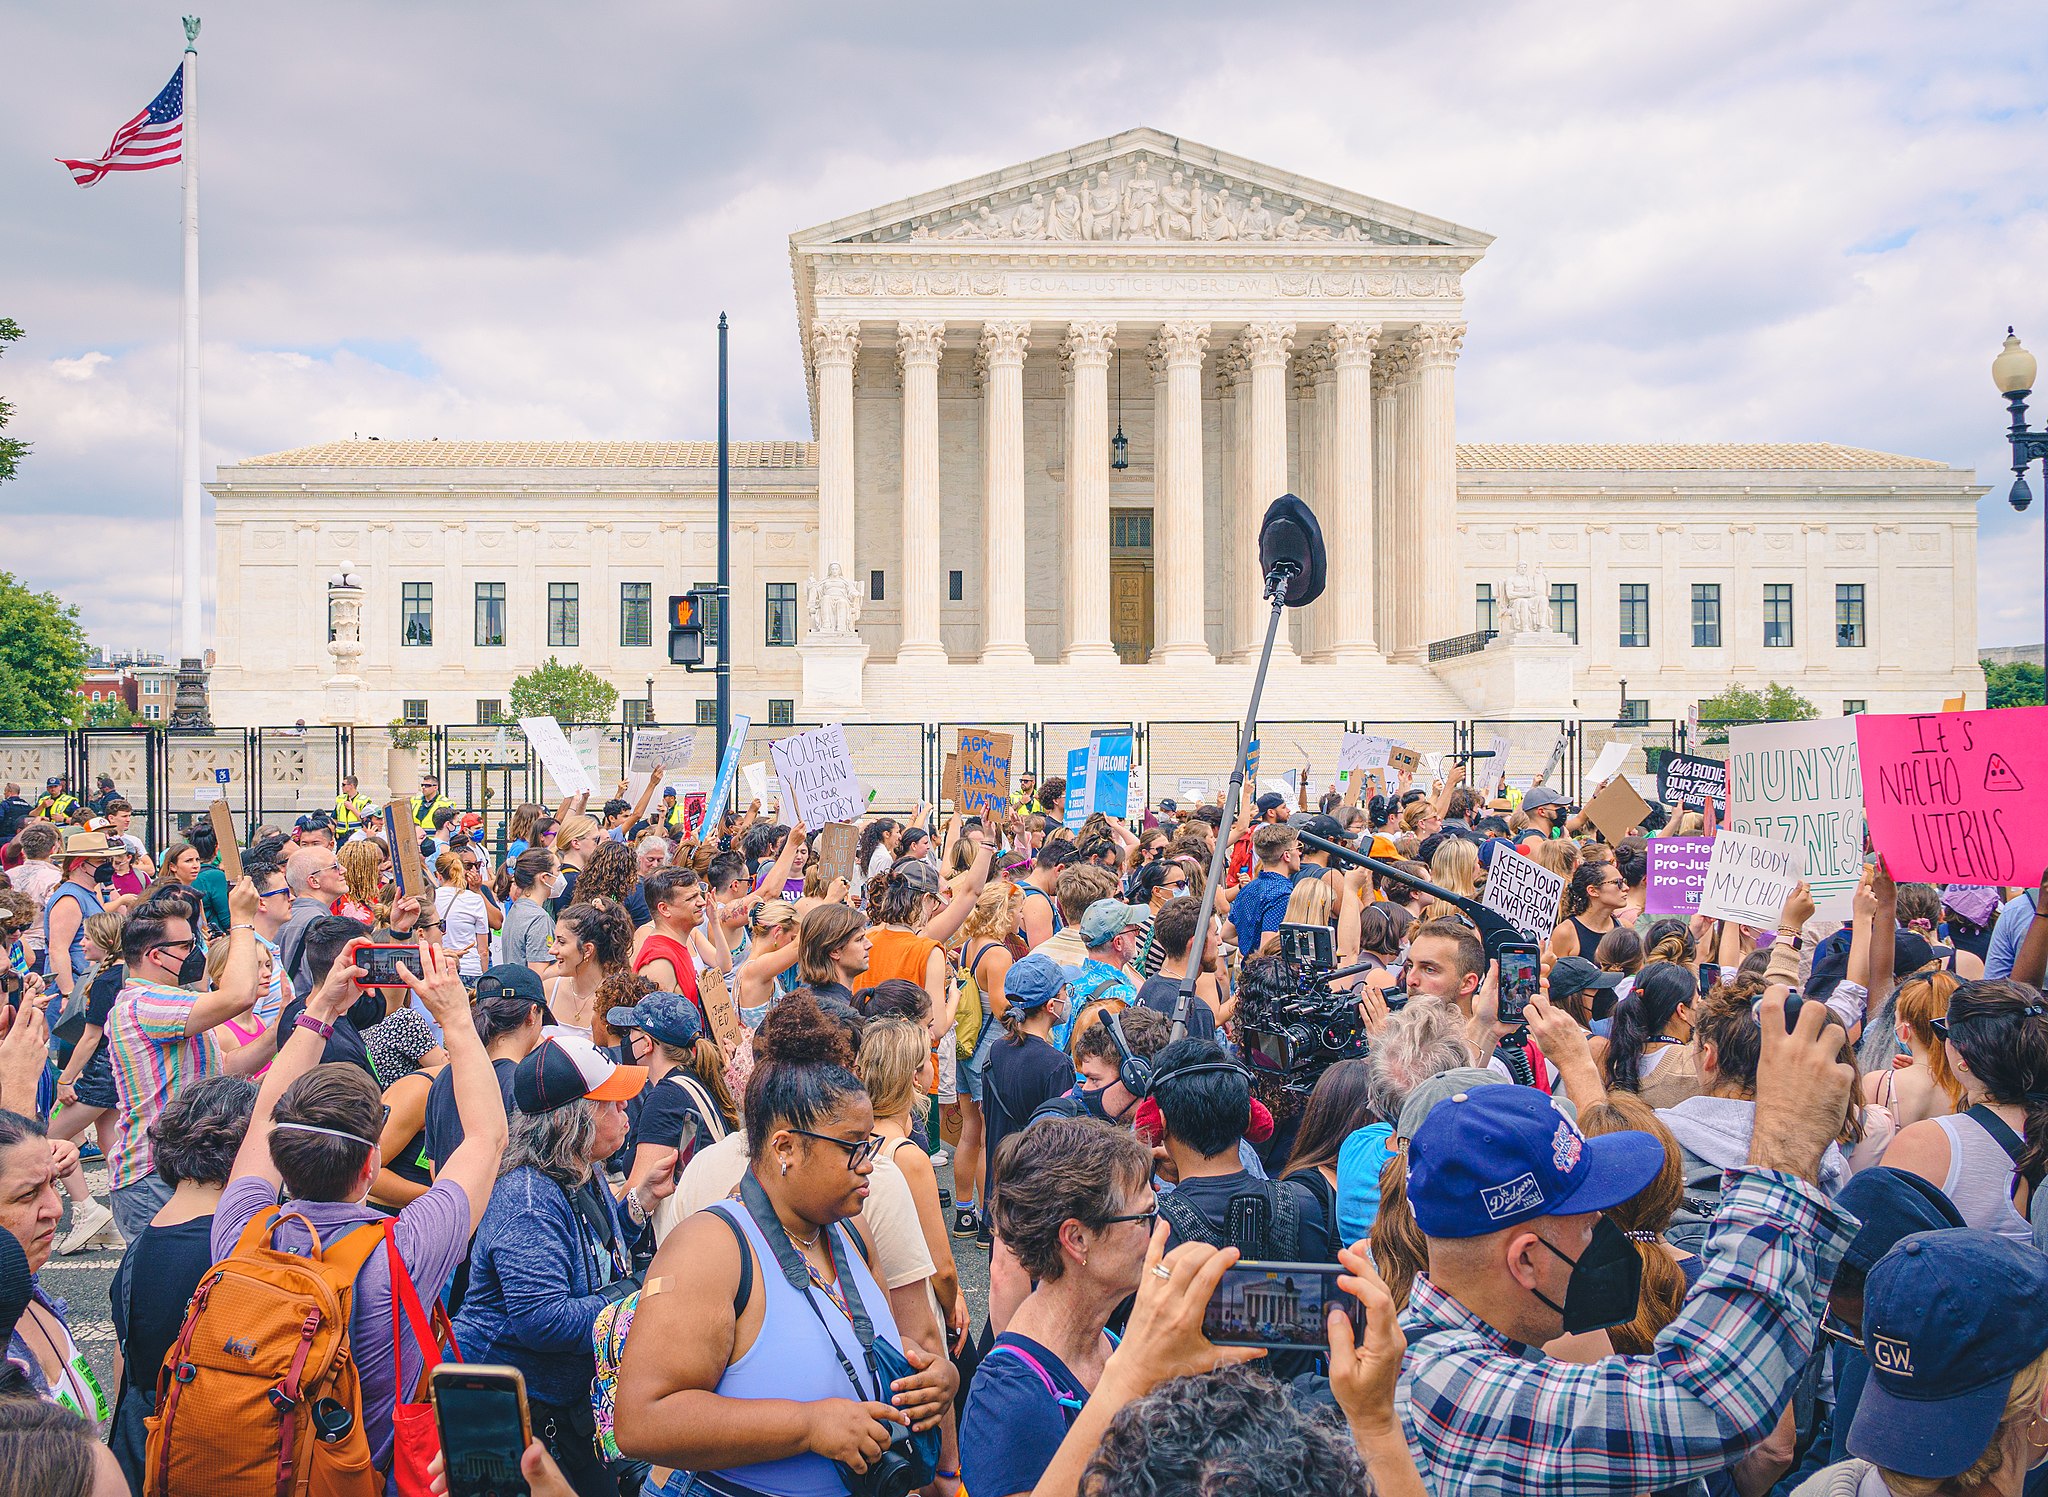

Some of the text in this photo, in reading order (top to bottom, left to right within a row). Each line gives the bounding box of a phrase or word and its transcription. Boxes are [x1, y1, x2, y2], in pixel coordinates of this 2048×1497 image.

[1018, 277, 1261, 293] EQUAL JUSTICE UNDER LAW
[774, 730, 841, 767] YOU ARE
[1908, 715, 1974, 753] It's
[815, 745, 841, 761] THE
[1097, 755, 1129, 772] WELCOME
[783, 759, 847, 793] VILLAIN
[1665, 775, 1692, 791] OUR
[1667, 758, 1726, 783] Our BODIE
[1733, 741, 1863, 802] NUNYA
[1879, 757, 1962, 806] NACHO
[806, 787, 840, 805] IN OUR
[1665, 787, 1684, 801] Our
[834, 849, 848, 863] YOU
[1654, 842, 1713, 854] Pro-Fre
[1719, 840, 1790, 877] MY BODY
[1911, 808, 2015, 882] UTERUS
[822, 863, 835, 878] IN
[1498, 850, 1561, 900] KEEP YOUR
[1490, 865, 1556, 917] RELIGION
[1710, 872, 1745, 903] MY
[1488, 886, 1526, 920] AWAY
[1525, 905, 1552, 934] FROM
